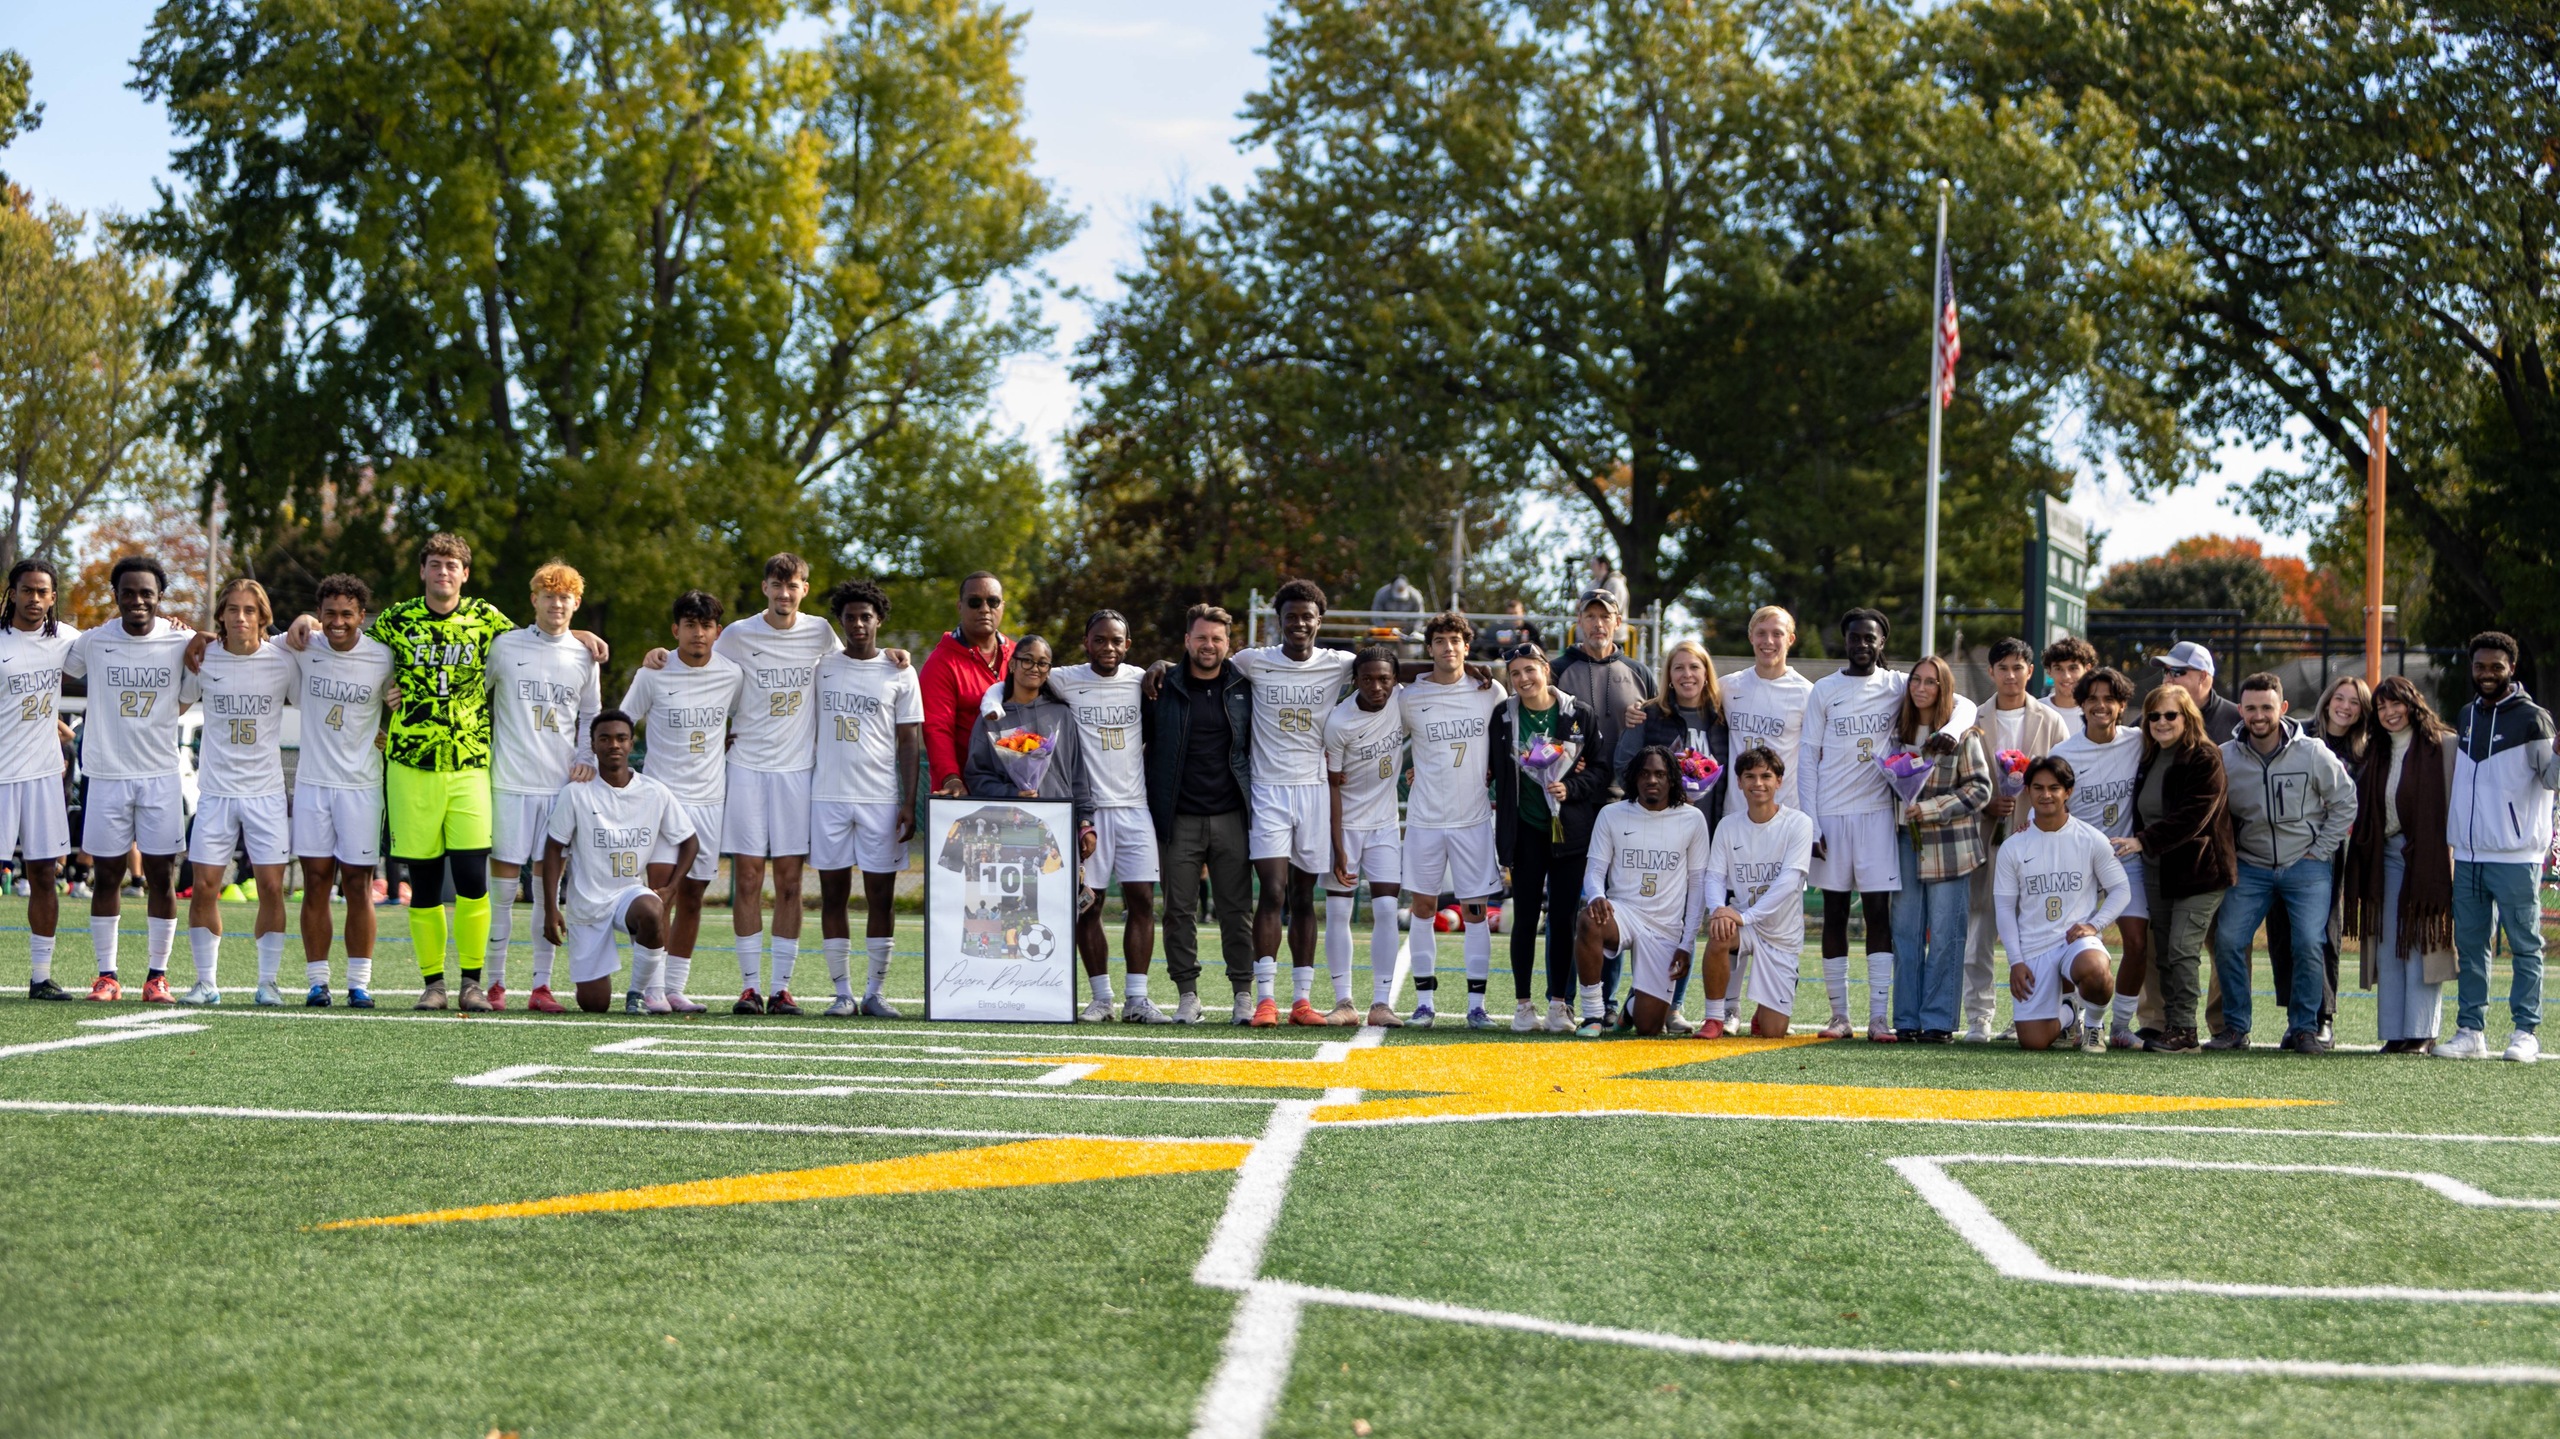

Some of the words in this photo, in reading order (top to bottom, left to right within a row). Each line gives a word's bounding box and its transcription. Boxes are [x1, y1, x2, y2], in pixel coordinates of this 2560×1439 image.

[413, 643, 475, 666] ELMS
[8, 668, 62, 695] ELMS
[107, 666, 171, 688] ELMS
[310, 675, 372, 705] ELMS
[437, 671, 448, 696] 1
[757, 666, 812, 689] ELMS
[120, 690, 157, 718] 27
[214, 694, 272, 715] ELMS
[517, 679, 574, 706] ELMS
[770, 690, 803, 717] 22
[823, 690, 880, 717] ELMS
[1266, 685, 1325, 705] ELMS
[22, 693, 53, 721] 24
[325, 704, 344, 731] 4
[532, 705, 559, 733] 14
[668, 706, 725, 729] ELMS
[1078, 705, 1138, 725] ELMS
[1279, 707, 1312, 732] 20
[229, 718, 257, 745] 15
[834, 715, 860, 742] 16
[1425, 718, 1486, 742] ELMS
[1730, 711, 1785, 738] ELMS
[1833, 713, 1892, 737] ELMS
[690, 731, 706, 754] 2
[1097, 727, 1126, 751] 10
[1857, 737, 1873, 763] 3
[1379, 754, 1394, 780] 6
[1449, 742, 1467, 768] 7
[2080, 777, 2136, 804] ELMS
[2102, 803, 2119, 828] 9
[593, 828, 652, 848] ELMS
[609, 851, 638, 878] 19
[1622, 848, 1681, 871] ELMS
[1734, 861, 1783, 883] ELMS
[983, 865, 1021, 894] 10
[1639, 872, 1658, 898] 5
[2025, 871, 2083, 896] ELMS
[2045, 895, 2063, 922] 8
[978, 1000, 997, 1009] Elms
[998, 1001, 1026, 1010] College
